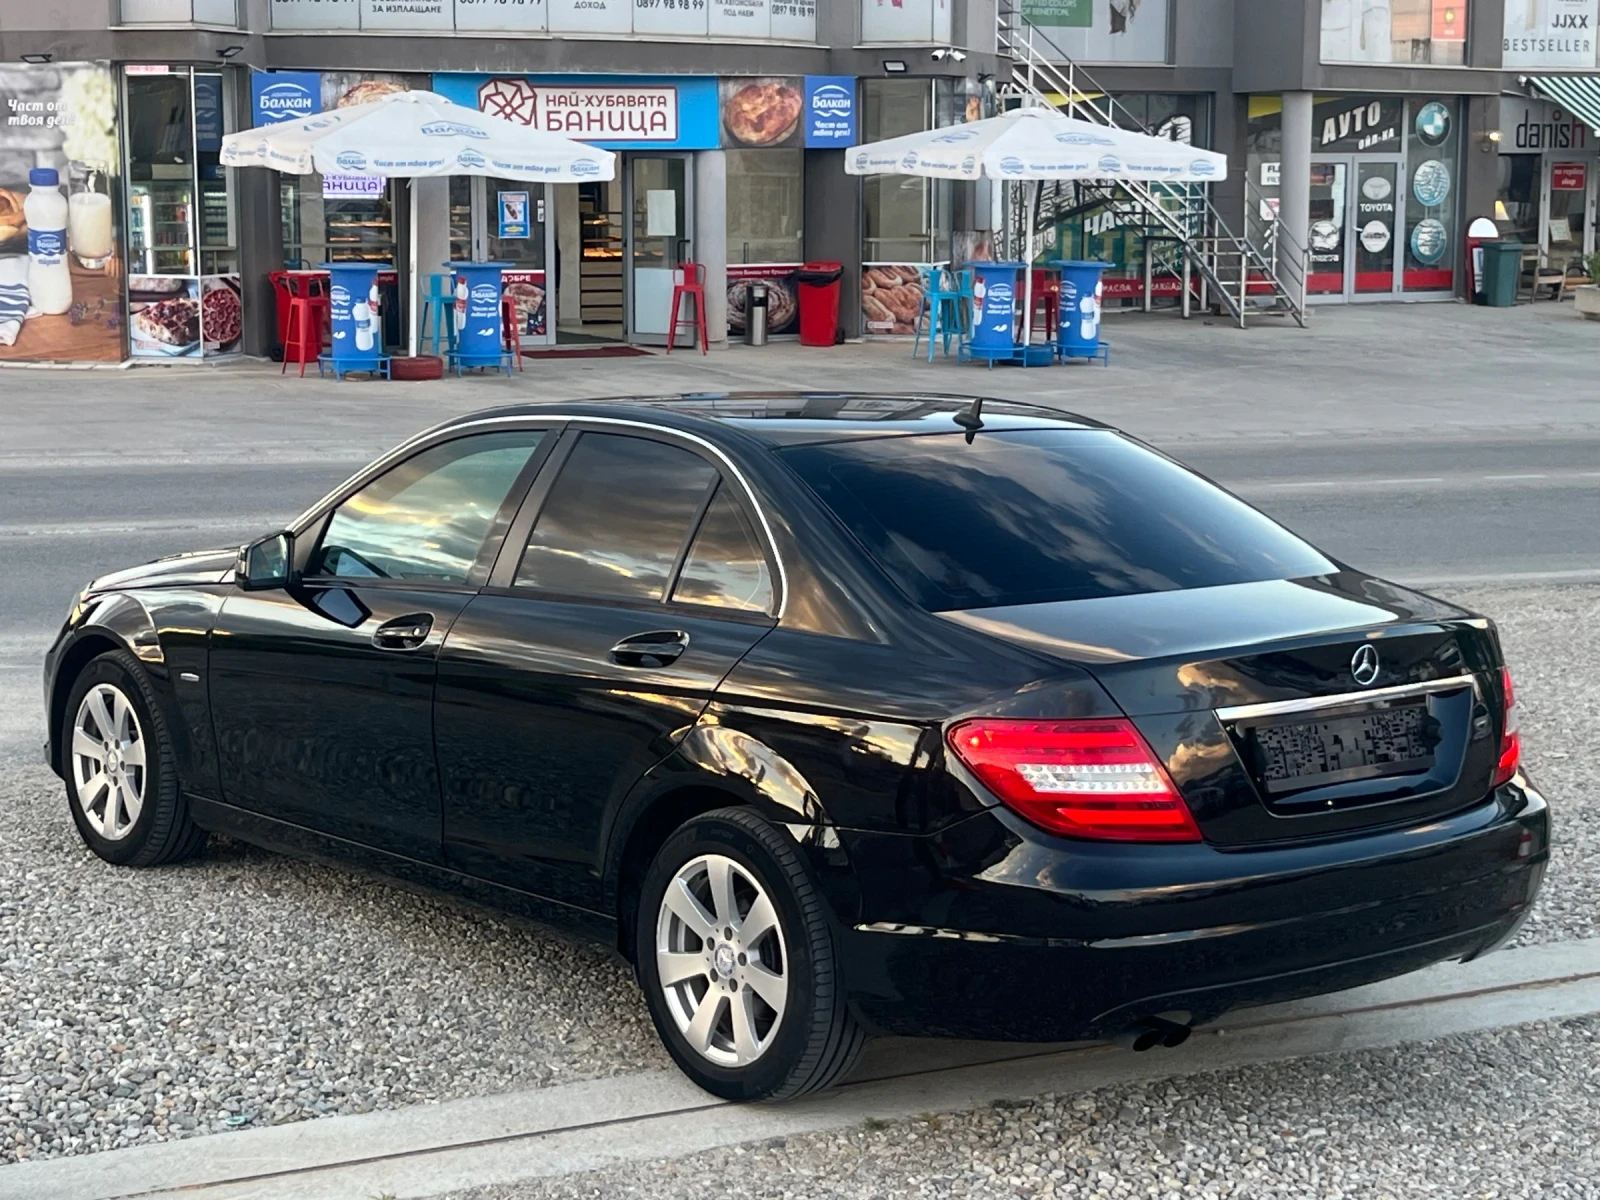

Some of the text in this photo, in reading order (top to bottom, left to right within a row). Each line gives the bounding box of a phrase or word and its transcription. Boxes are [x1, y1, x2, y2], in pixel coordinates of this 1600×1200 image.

[386, 5, 442, 13] ИЗПЛАЩАНЕ
[1552, 14, 1588, 28] JJXX
[1504, 39, 1590, 52] BESTSELLER
[8, 99, 44, 112] Част
[260, 95, 312, 109] Балкан
[546, 91, 667, 107] НАЙ-ХУБАВАТА
[812, 95, 851, 109] Балкан
[8, 114, 44, 126] твоя
[546, 110, 667, 136] БАНИЦА
[1516, 109, 1585, 148] danish
[1360, 203, 1393, 212] TOYOTA
